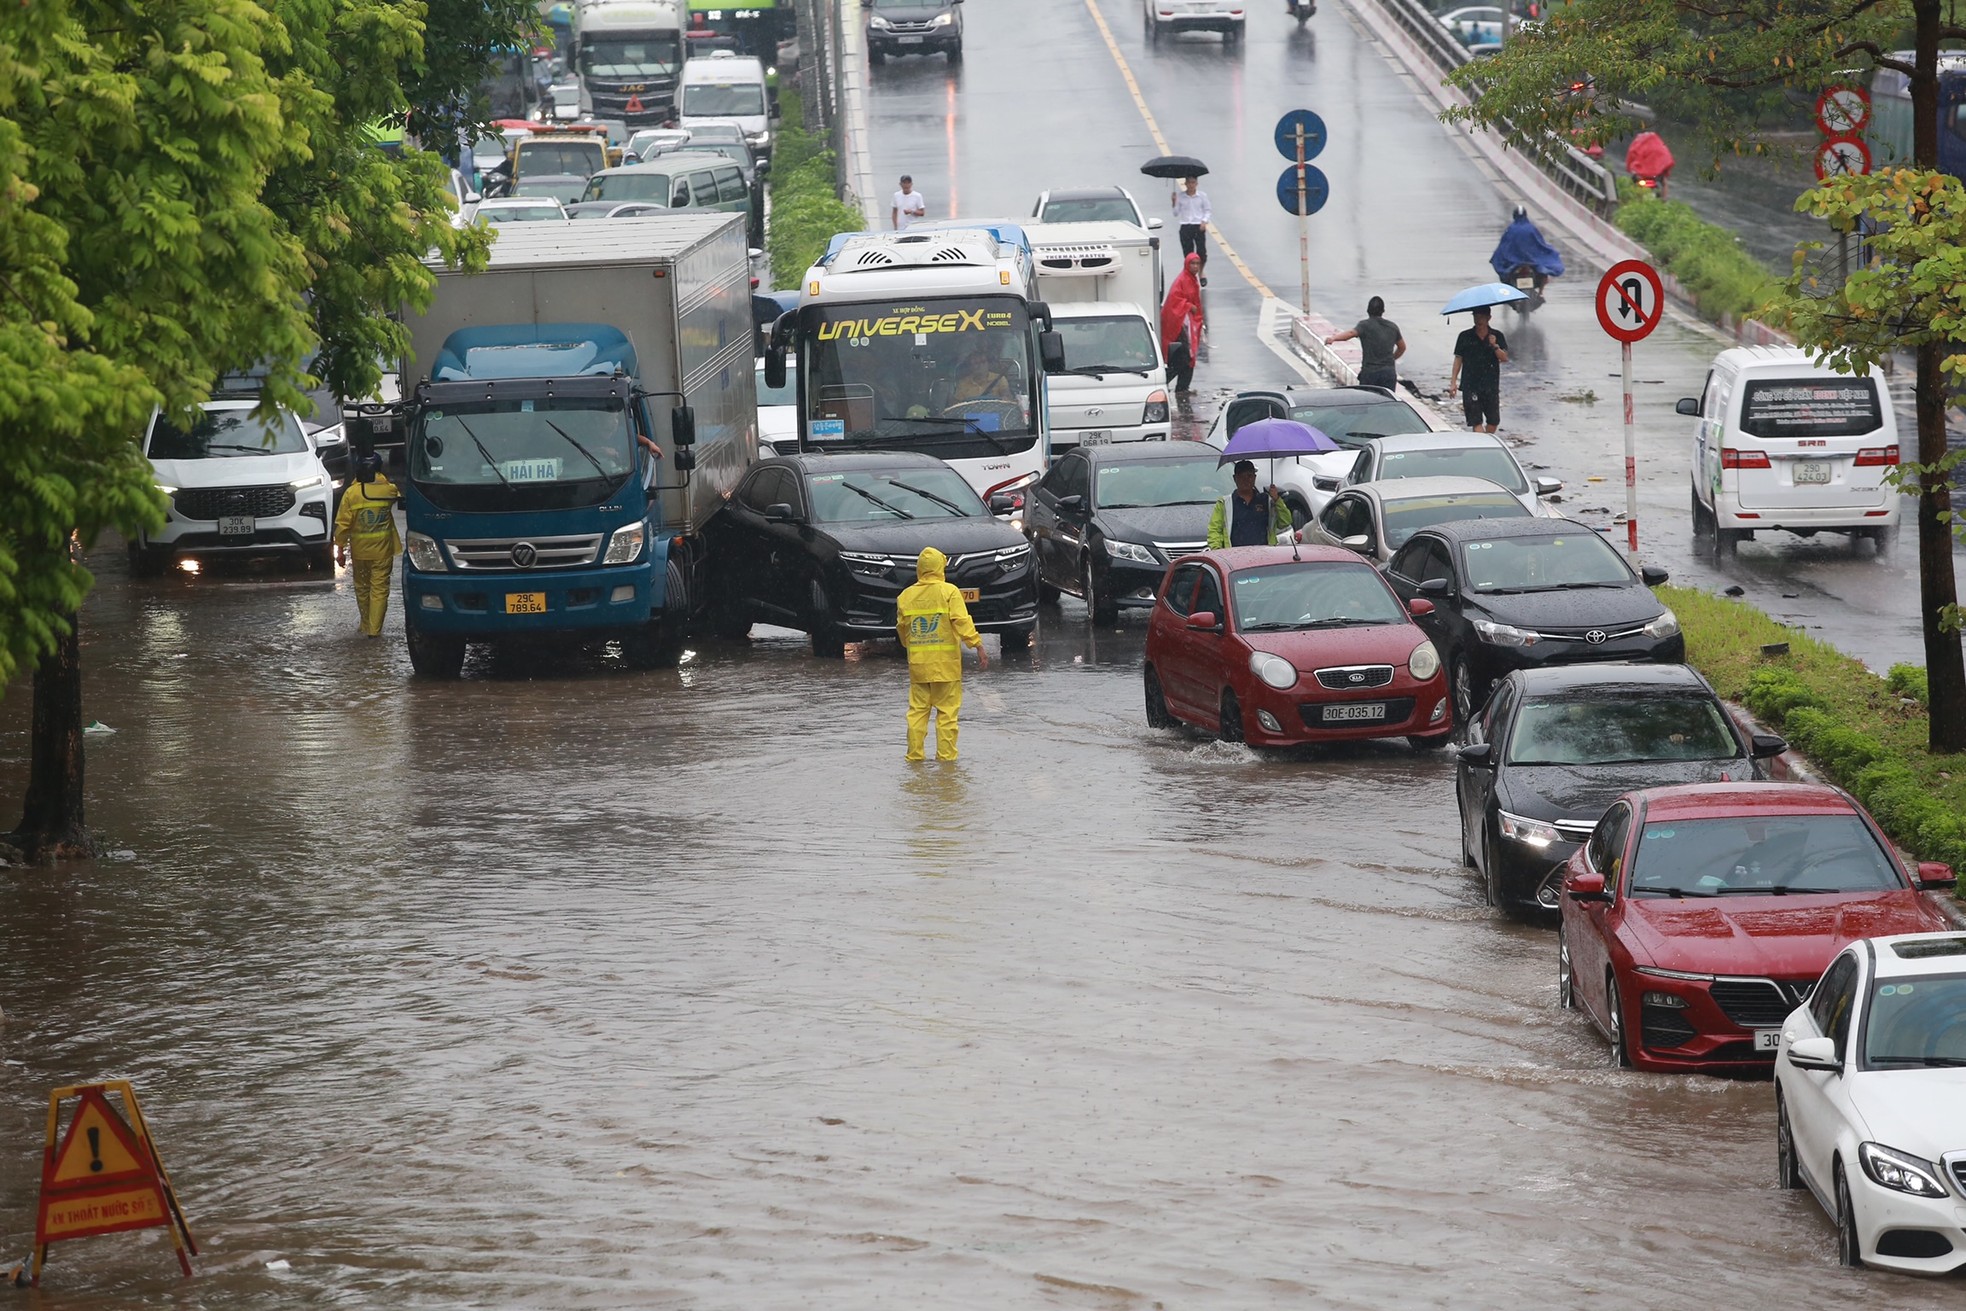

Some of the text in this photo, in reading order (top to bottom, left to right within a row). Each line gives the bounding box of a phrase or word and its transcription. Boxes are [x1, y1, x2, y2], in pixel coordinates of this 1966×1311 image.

[619, 84, 645, 92] JAC
[510, 461, 555, 480] HẢI HÀ
[229, 517, 244, 525] 30K
[517, 594, 534, 604] 29C
[510, 603, 542, 612] 789.64
